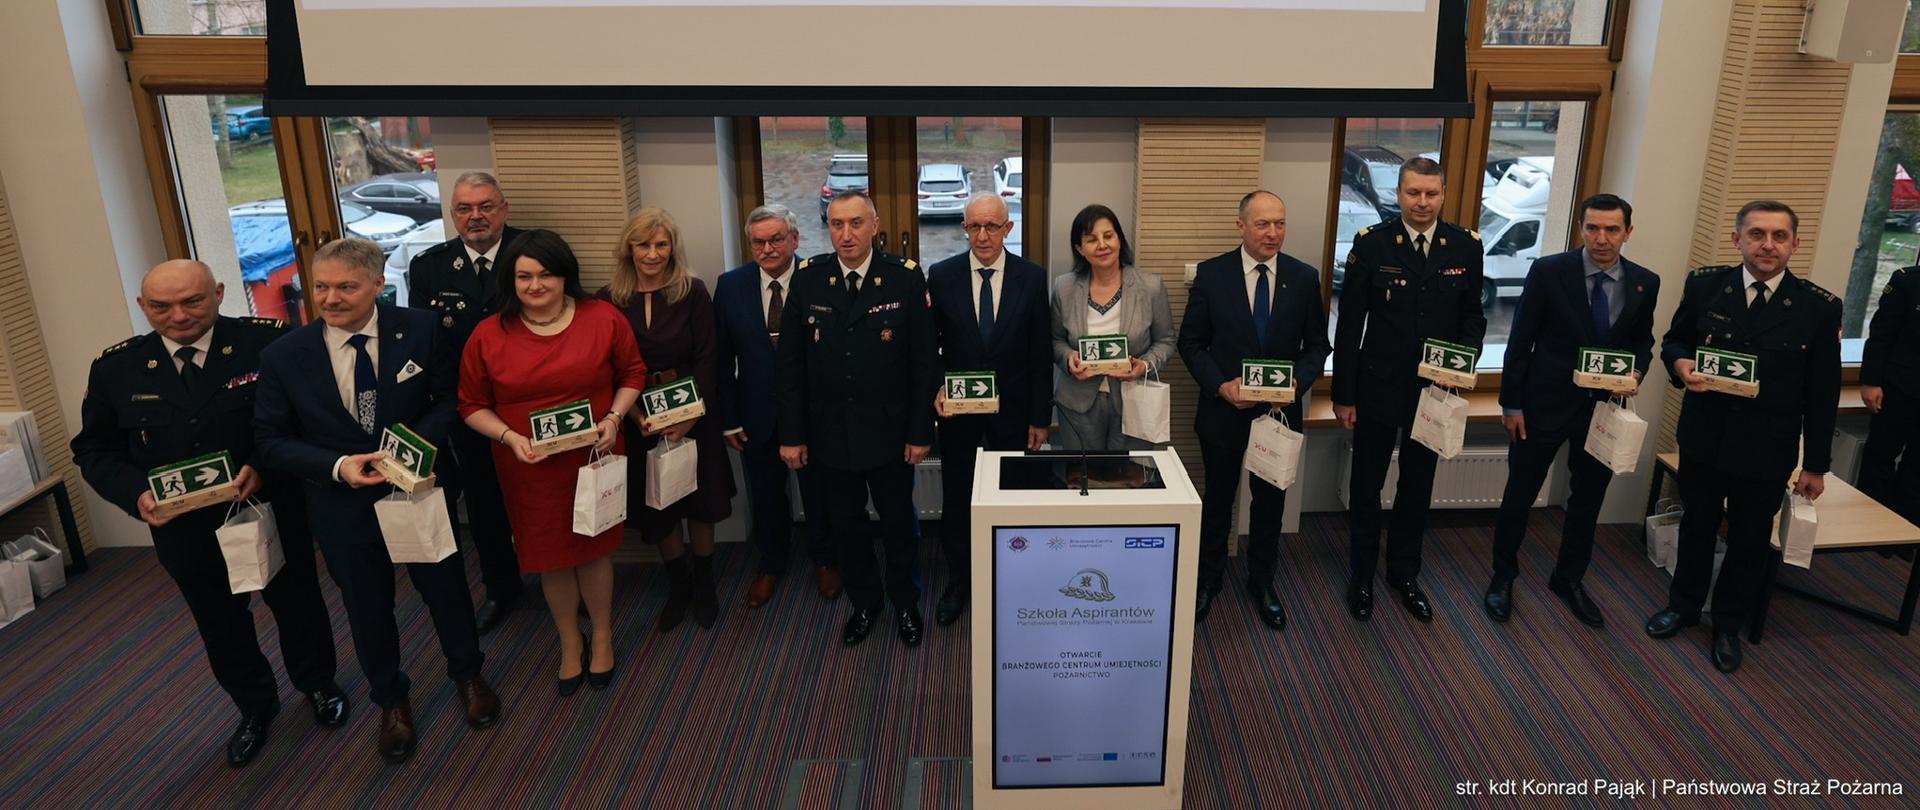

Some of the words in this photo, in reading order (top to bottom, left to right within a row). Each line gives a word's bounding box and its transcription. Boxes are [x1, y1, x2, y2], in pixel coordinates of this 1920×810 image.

[1016, 607, 1067, 619] Szkoła
[1071, 606, 1155, 620] Aspirantów
[1059, 651, 1103, 659] OTWARCIE
[1001, 661, 1061, 670] BRANŻOWEGO
[1062, 661, 1102, 669] CENTRUM
[1103, 660, 1162, 670] UMIEJĘTNOŚCI
[1052, 671, 1111, 679] POŻARNICTWO
